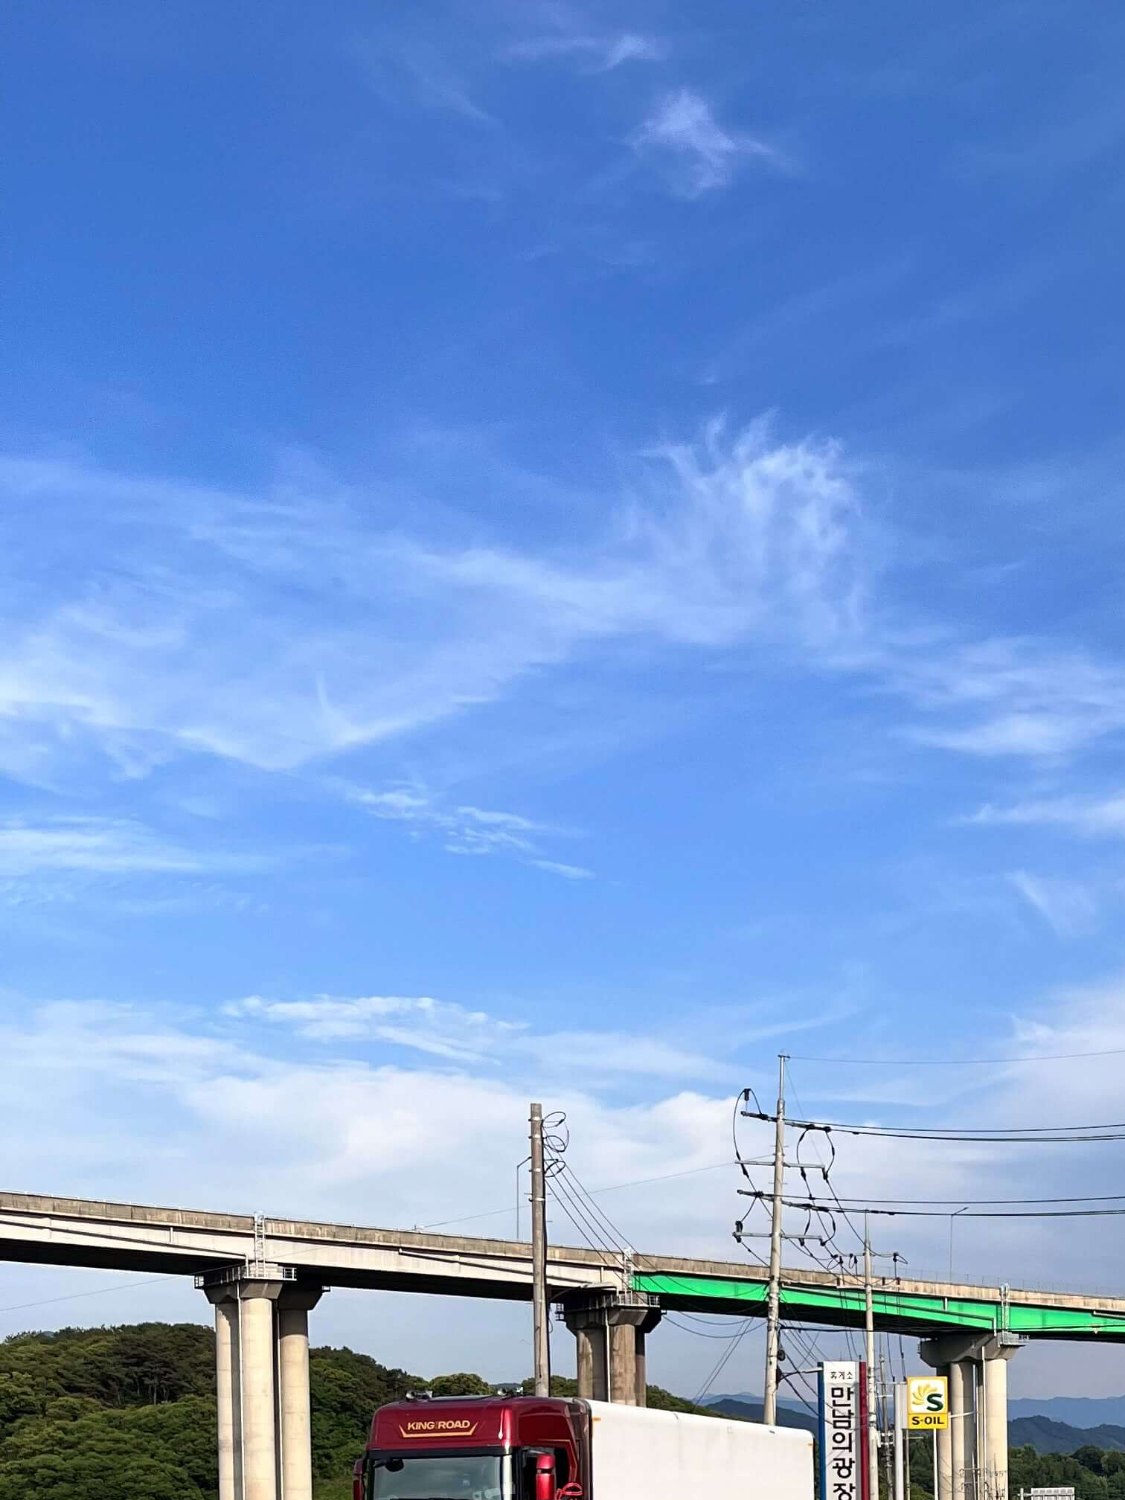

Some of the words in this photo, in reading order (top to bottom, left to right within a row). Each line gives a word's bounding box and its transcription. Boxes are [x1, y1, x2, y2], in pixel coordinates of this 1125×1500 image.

[830, 1371, 853, 1380] 휴게소
[926, 1393, 944, 1412] S
[407, 1421, 435, 1431] KING
[437, 1420, 471, 1430] ROAD
[911, 1416, 945, 1426] S-OIL
